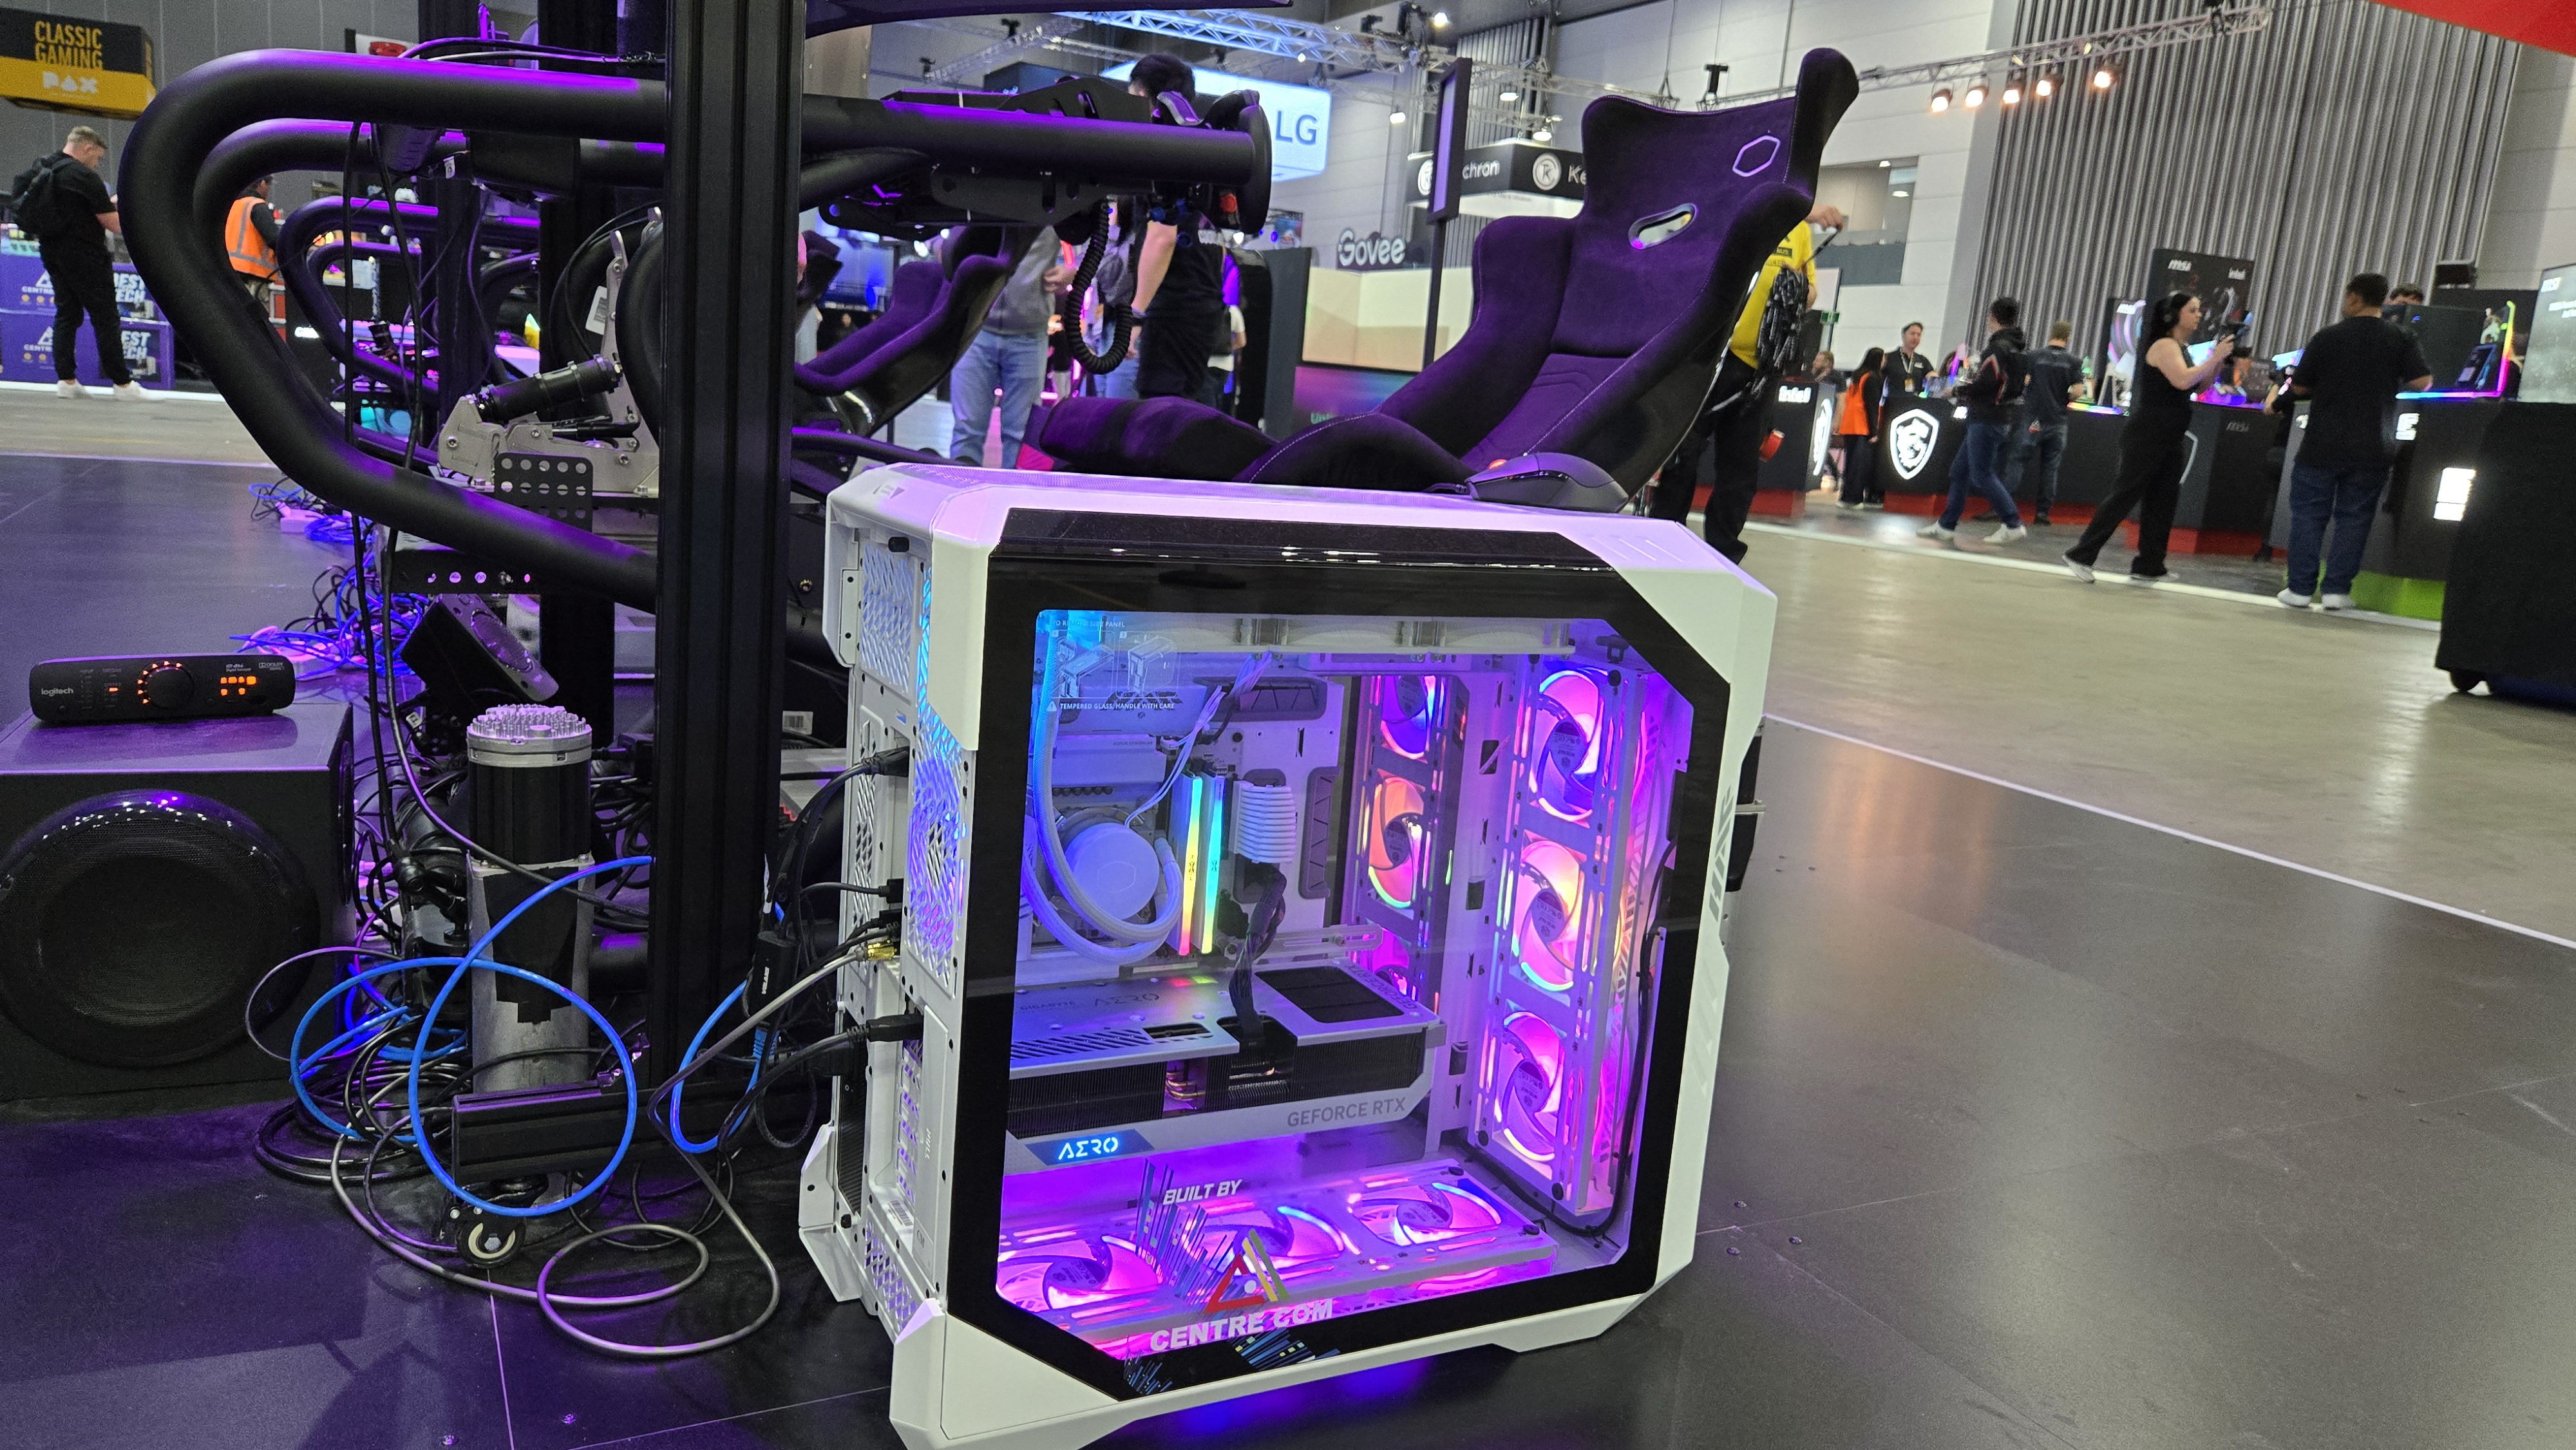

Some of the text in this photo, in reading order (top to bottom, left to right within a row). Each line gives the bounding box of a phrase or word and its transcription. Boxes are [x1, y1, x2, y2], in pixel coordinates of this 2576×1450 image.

[34, 20, 102, 50] CLASSIC
[35, 41, 104, 70] GAMING
[42, 71, 99, 94] PAX
[1275, 110, 1318, 146] LG
[1462, 160, 1501, 180] chron
[1338, 229, 1405, 267] Govee
[115, 289, 146, 304] ECH
[120, 330, 151, 347] EST
[1778, 384, 1812, 403] intel
[41, 687, 74, 697] logitech
[1364, 977, 1417, 1010] GEFORCE
[1287, 1097, 1406, 1127] GEFORCE RTX
[1058, 1136, 1119, 1160] AERO
[1162, 1179, 1243, 1205] BUILT BY
[1150, 1298, 1333, 1352] CENTRE COM
